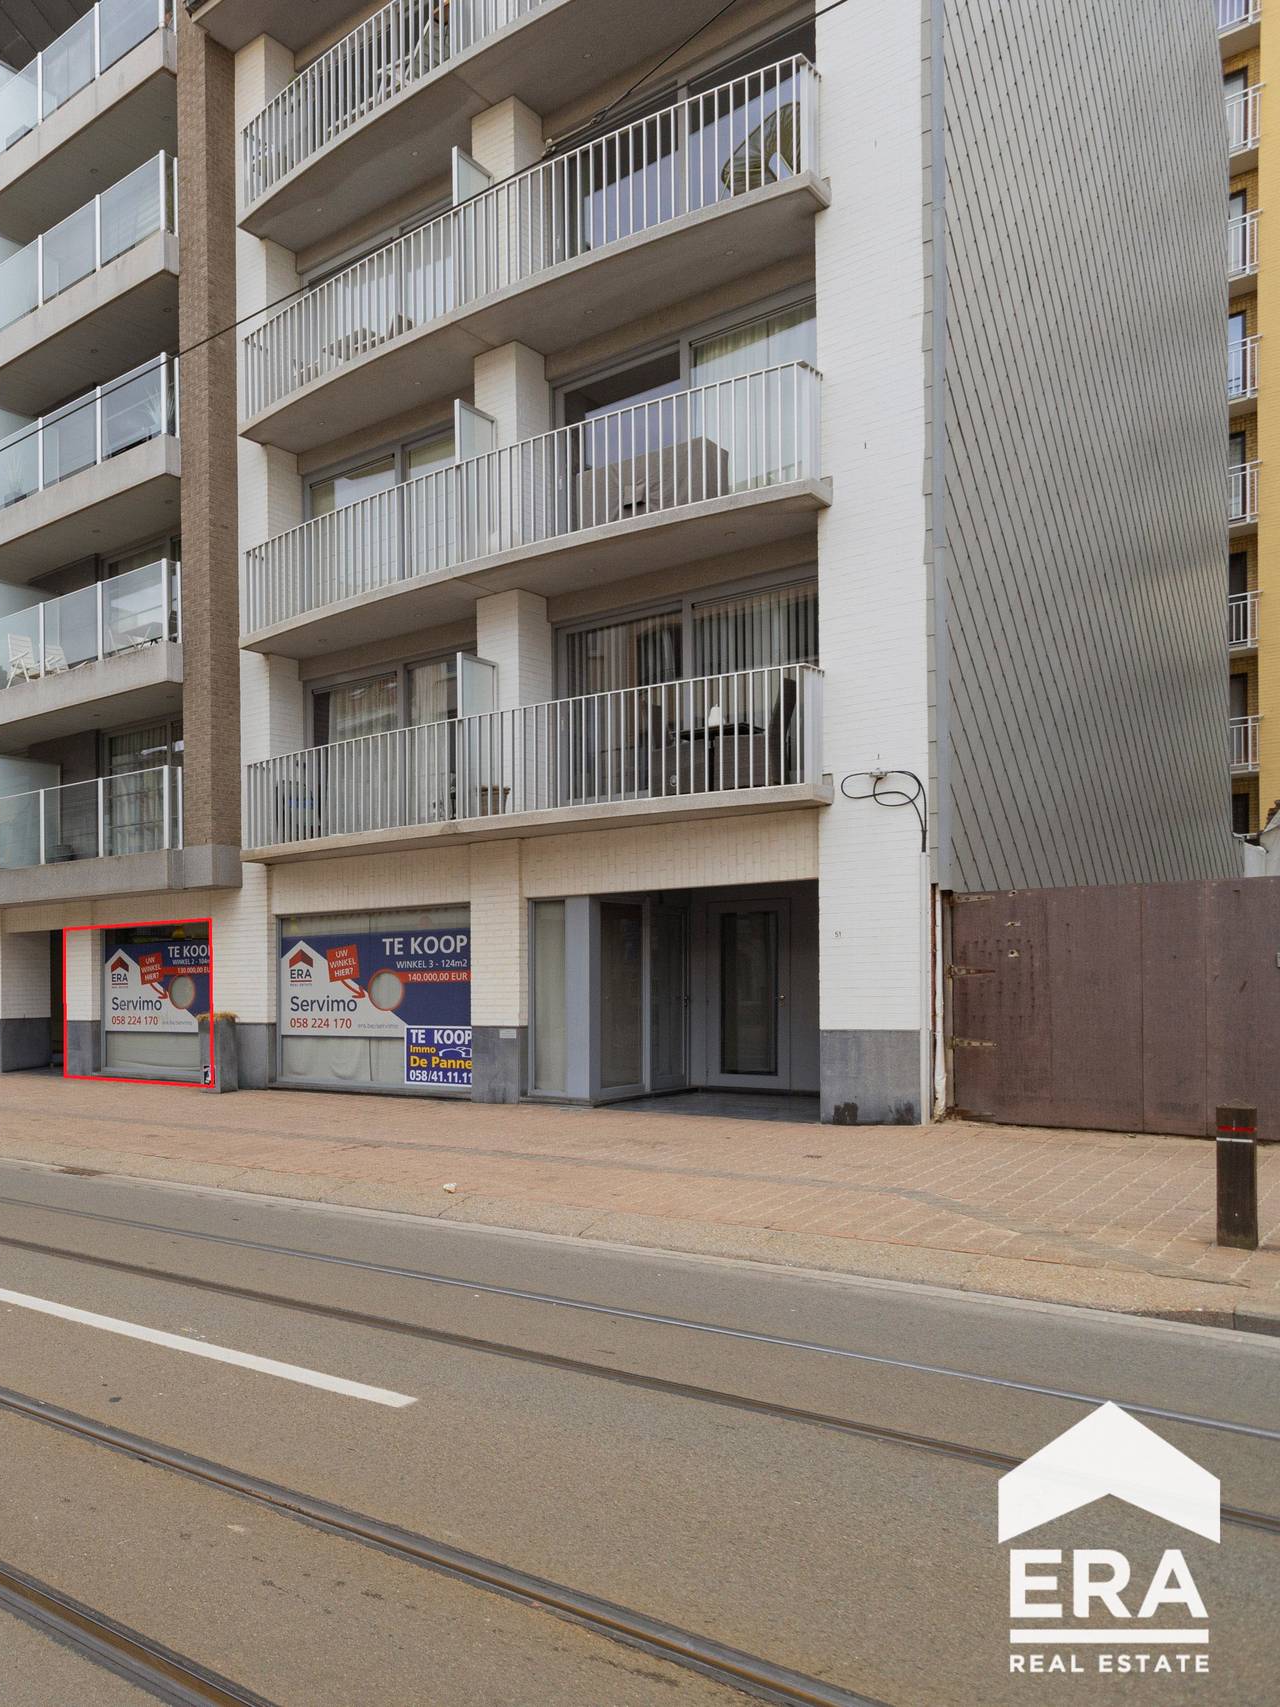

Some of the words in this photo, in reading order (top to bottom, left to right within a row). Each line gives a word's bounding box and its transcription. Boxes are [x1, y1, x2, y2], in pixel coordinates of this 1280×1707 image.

[382, 937, 404, 956] TE
[410, 934, 468, 955] KOOP
[168, 946, 180, 958] TE
[335, 949, 348, 958] UW
[329, 958, 357, 969] WINKEL
[396, 960, 427, 969] WINKEL
[429, 959, 434, 968] 3
[441, 958, 468, 968] 124m2
[112, 974, 128, 982] ERA
[290, 969, 312, 979] ERA
[335, 967, 354, 978] HIER?
[451, 972, 468, 981] EUR
[112, 996, 162, 1011] Servimo
[290, 995, 358, 1012] Servimo
[112, 1015, 126, 1025] 058
[127, 1015, 141, 1025] 224
[144, 1015, 158, 1025] 170
[290, 1017, 309, 1029] 058
[311, 1017, 330, 1029] 224
[334, 1017, 352, 1029] 170
[410, 1029, 426, 1044] TE
[434, 1029, 472, 1045] KOOP
[410, 1045, 437, 1054] Immo
[410, 1055, 428, 1067] De
[431, 1056, 472, 1069] Panne
